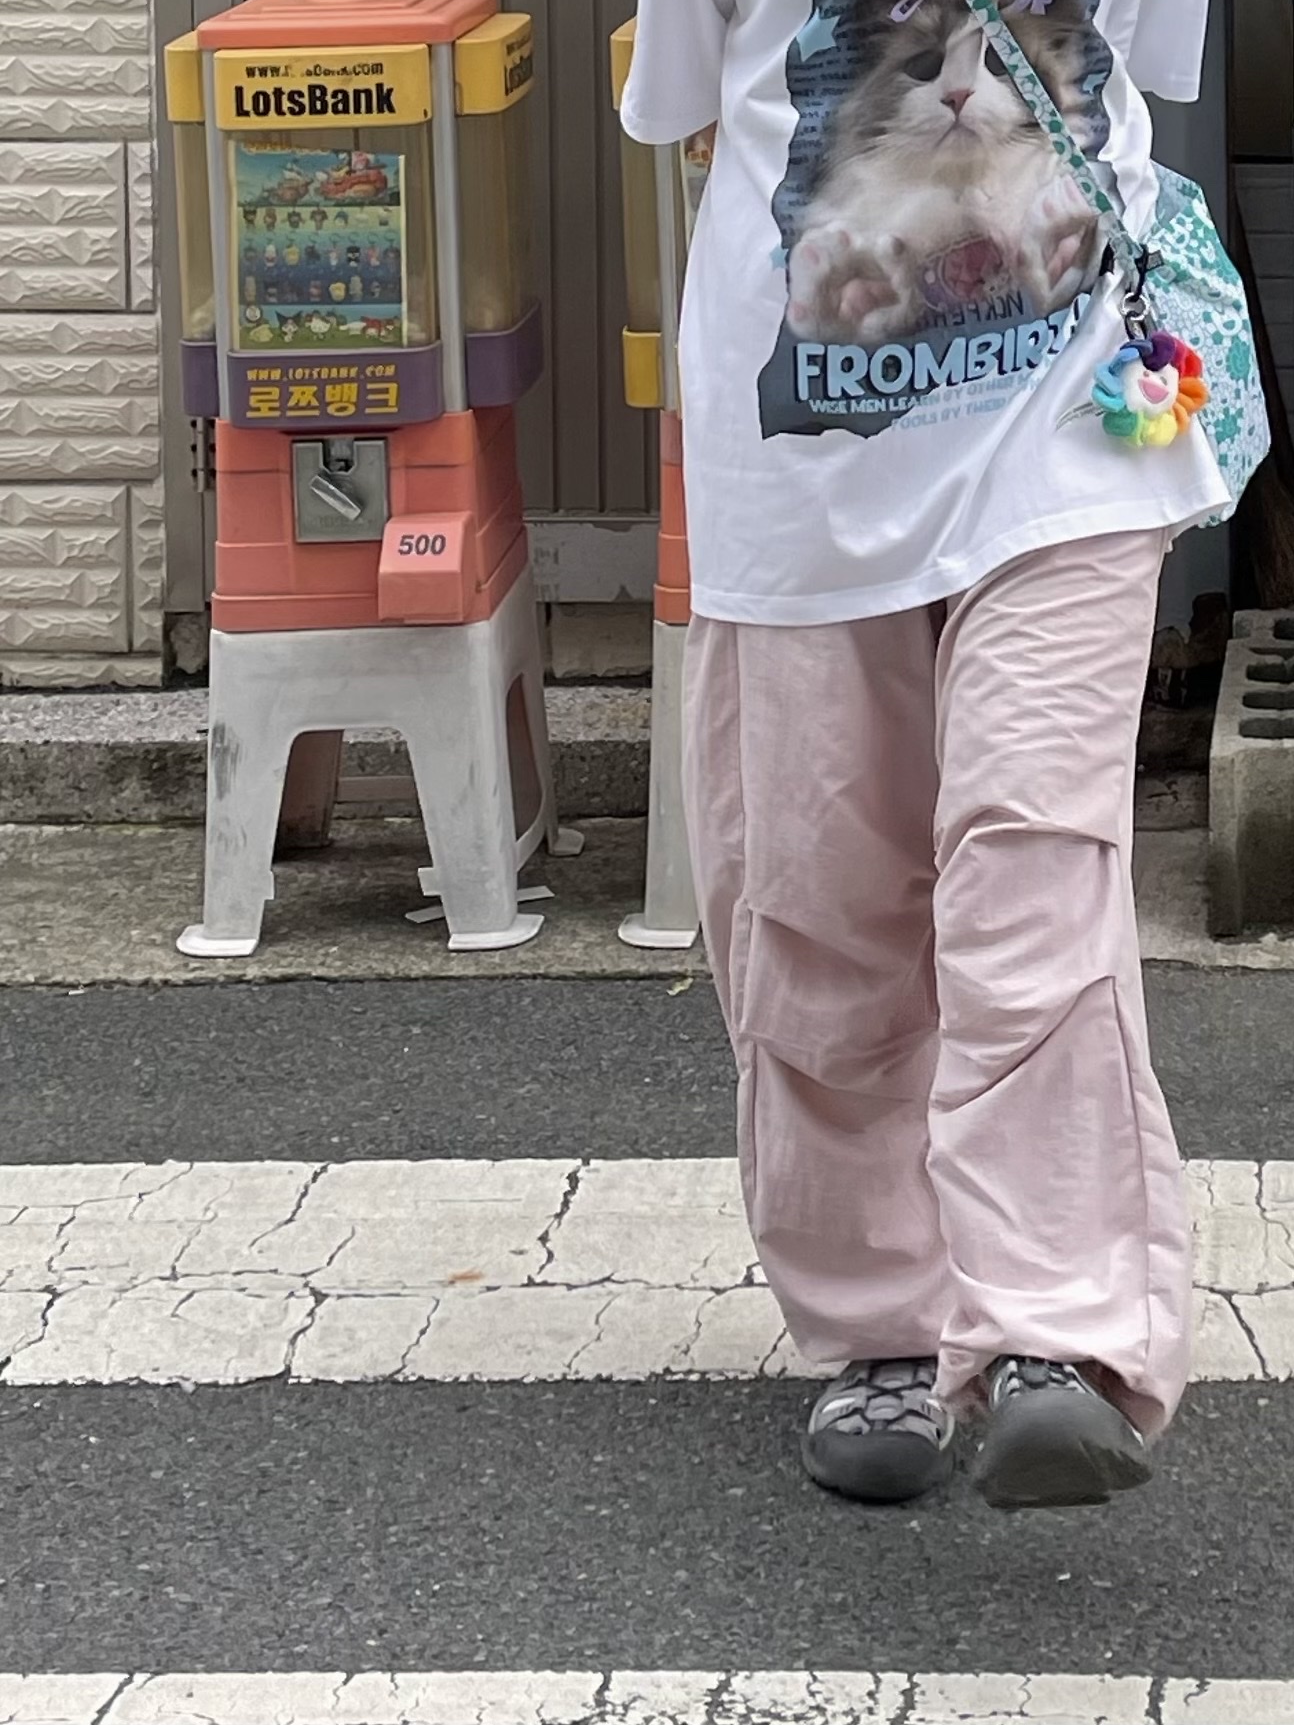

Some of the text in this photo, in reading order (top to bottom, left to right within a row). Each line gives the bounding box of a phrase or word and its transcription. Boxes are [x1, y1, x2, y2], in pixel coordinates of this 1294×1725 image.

[234, 83, 396, 117] LotsBank
[246, 382, 398, 418] 로쯔뱅크
[809, 399, 847, 414] WISE
[850, 398, 887, 414] MEN
[398, 534, 446, 556] 500
